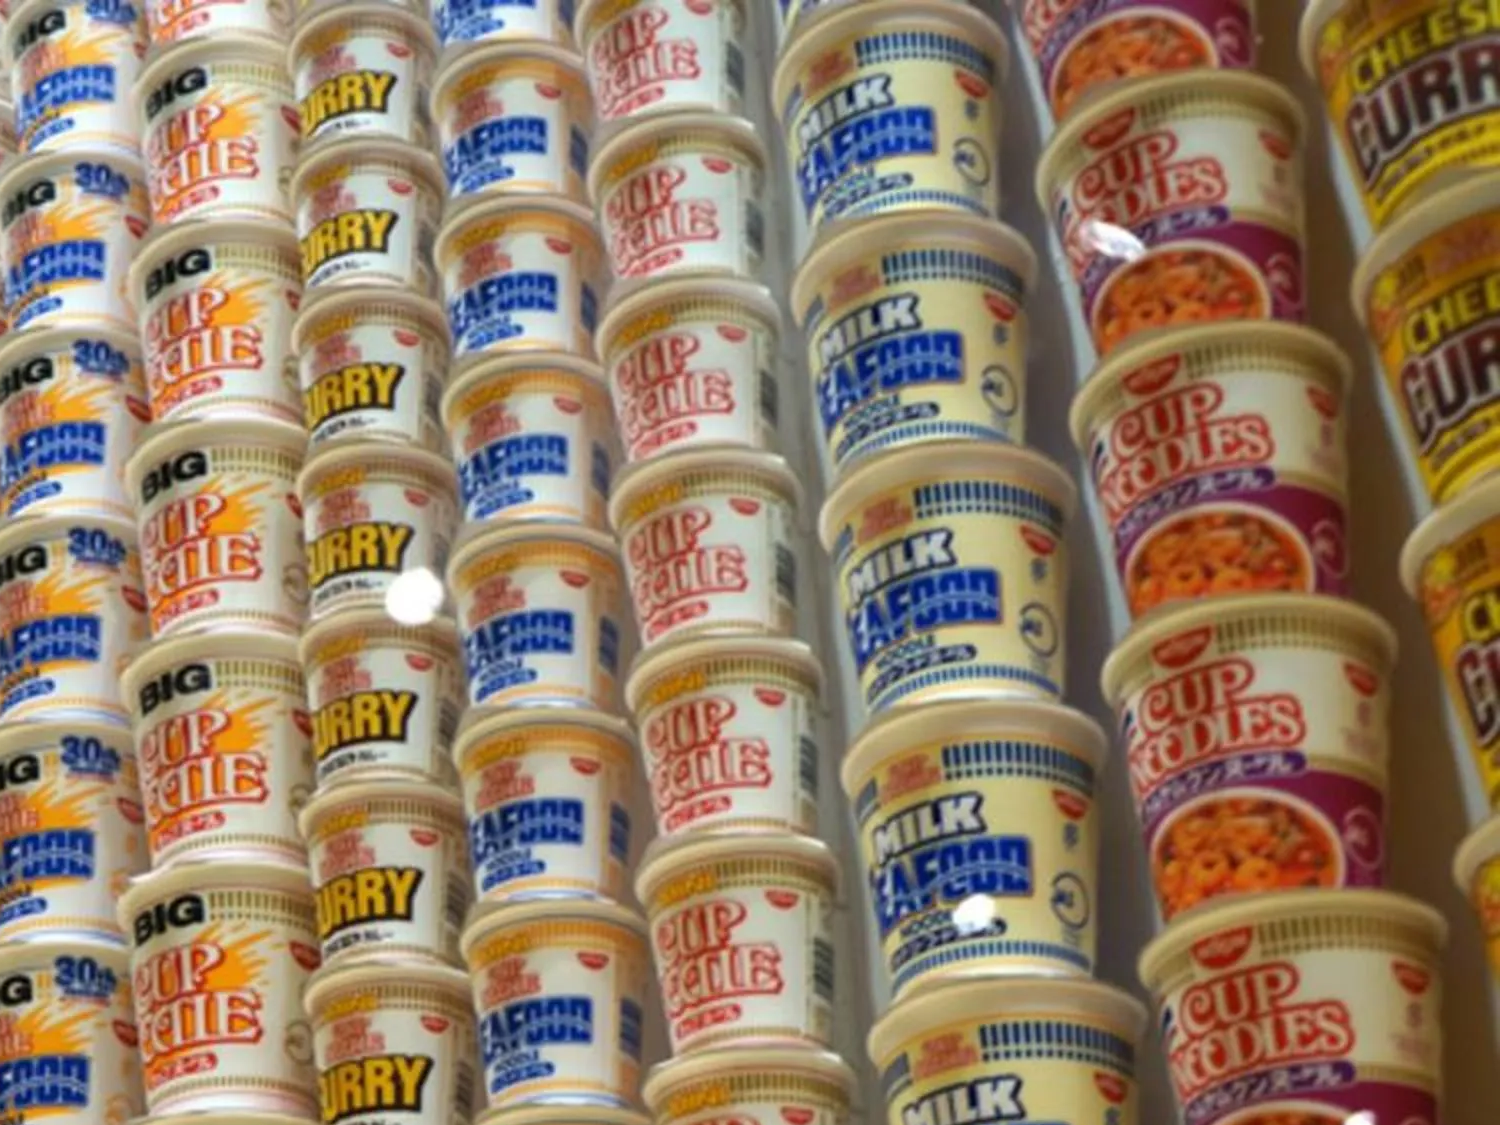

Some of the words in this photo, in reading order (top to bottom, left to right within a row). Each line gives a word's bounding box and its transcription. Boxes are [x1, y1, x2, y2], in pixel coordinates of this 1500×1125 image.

[146, 66, 208, 120] BIG
[300, 69, 398, 132] URRY
[800, 73, 895, 154] MILK
[1345, 36, 1500, 194] CURR
[1073, 129, 1181, 208] CUP
[300, 208, 400, 270] URRY
[146, 247, 212, 299] BIG
[817, 293, 923, 372] MILK
[302, 362, 406, 428] URRY
[1109, 382, 1225, 463] CUP
[141, 448, 208, 503] BIG
[306, 520, 416, 587] URRY
[843, 527, 958, 600] MILK
[138, 661, 211, 714] BIG
[1137, 658, 1255, 740] CUP
[310, 689, 419, 754] URRY
[872, 791, 987, 866] MILK
[132, 894, 205, 946] BIG
[314, 866, 423, 930] URRY
[1175, 960, 1301, 1045] CUP
[320, 1055, 434, 1118] URRY
